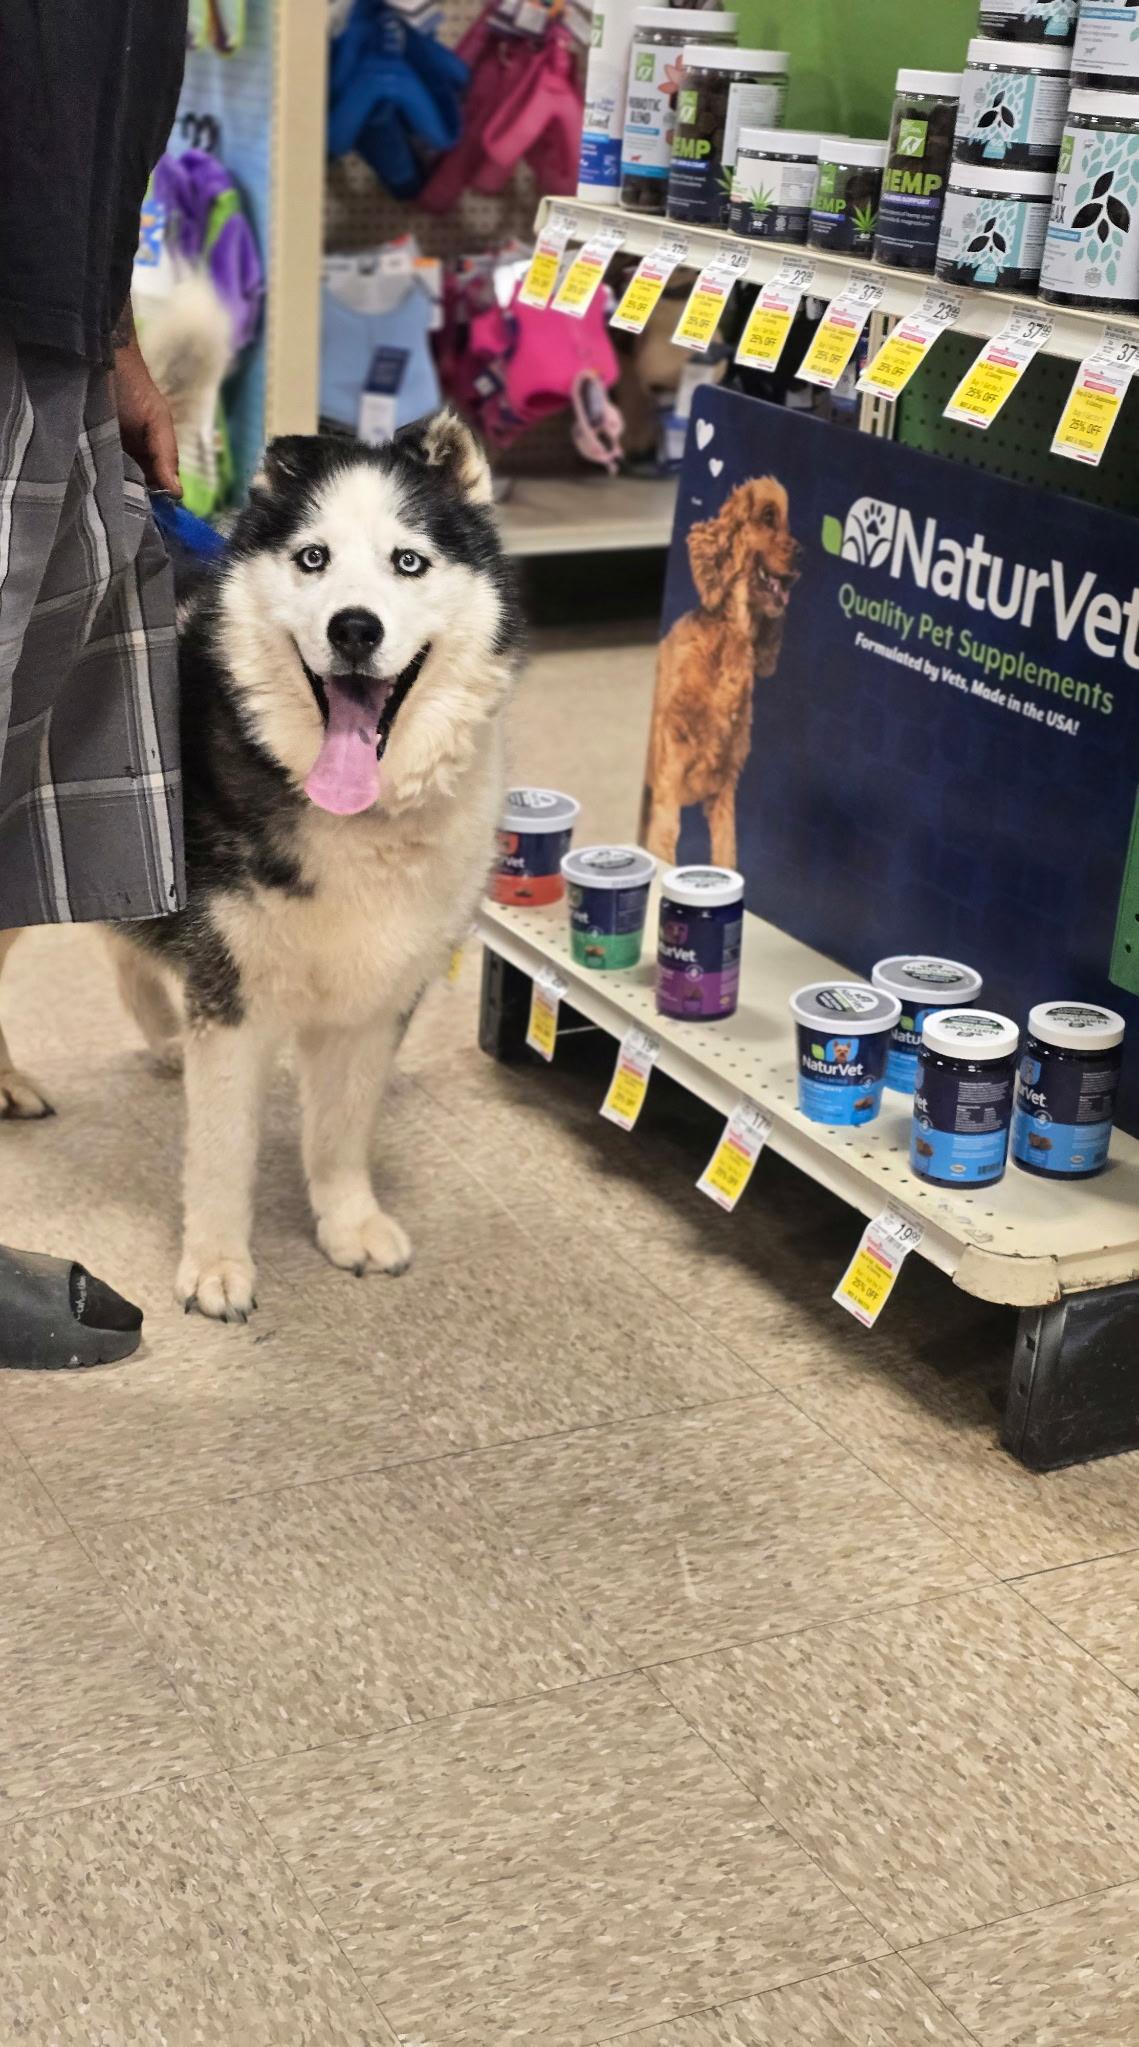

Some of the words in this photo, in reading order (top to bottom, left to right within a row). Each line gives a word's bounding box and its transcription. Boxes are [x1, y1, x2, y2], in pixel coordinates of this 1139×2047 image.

[672, 136, 712, 160] EMP
[965, 386, 983, 399] 25%
[982, 391, 1000, 403] OFF
[1069, 418, 1086, 432] 25%
[1086, 423, 1103, 436] OFF
[890, 507, 1139, 671] NaturVet
[839, 582, 914, 641] Quality
[918, 613, 954, 650] Pet
[957, 629, 1115, 715] Supplements
[855, 631, 923, 672] Formulated
[923, 659, 940, 683] by
[941, 666, 970, 694] Vets,
[970, 679, 1007, 707] Made
[1007, 693, 1021, 713] in
[1021, 701, 1045, 722] the
[1045, 709, 1081, 737] USA!
[890, 1027, 922, 1045] Natu
[802, 1054, 864, 1077] NaturVet
